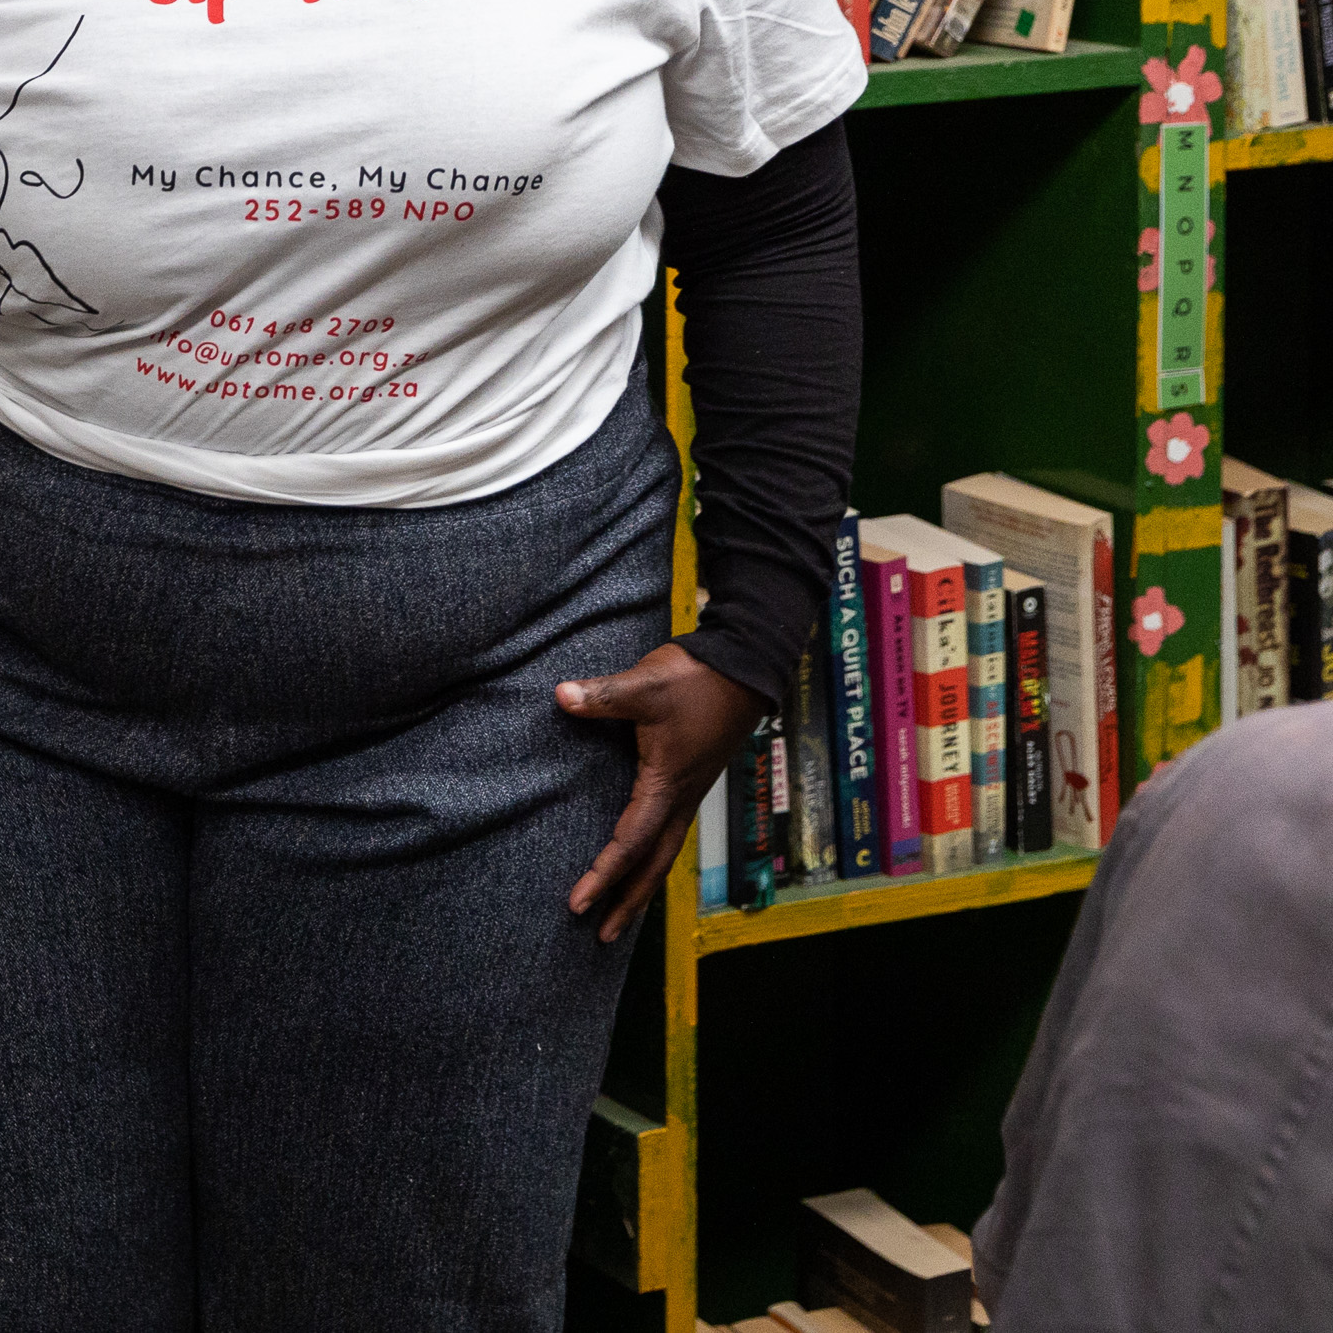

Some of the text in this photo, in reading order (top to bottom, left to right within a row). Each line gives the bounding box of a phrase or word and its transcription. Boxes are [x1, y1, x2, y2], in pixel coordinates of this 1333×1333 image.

[131, 165, 544, 196] My Chance, My Change
[245, 198, 475, 222] 252-589 NPO
[1171, 130, 1194, 398] M N O P Q R S
[210, 310, 395, 339] 061 488 2709
[136, 357, 419, 404] www.uptome.org.za
[836, 536, 857, 600] SUCH
[839, 606, 855, 624] A
[841, 628, 863, 700] QUIET
[846, 707, 869, 782] PLACE
[754, 753, 769, 852] SATURDAY
